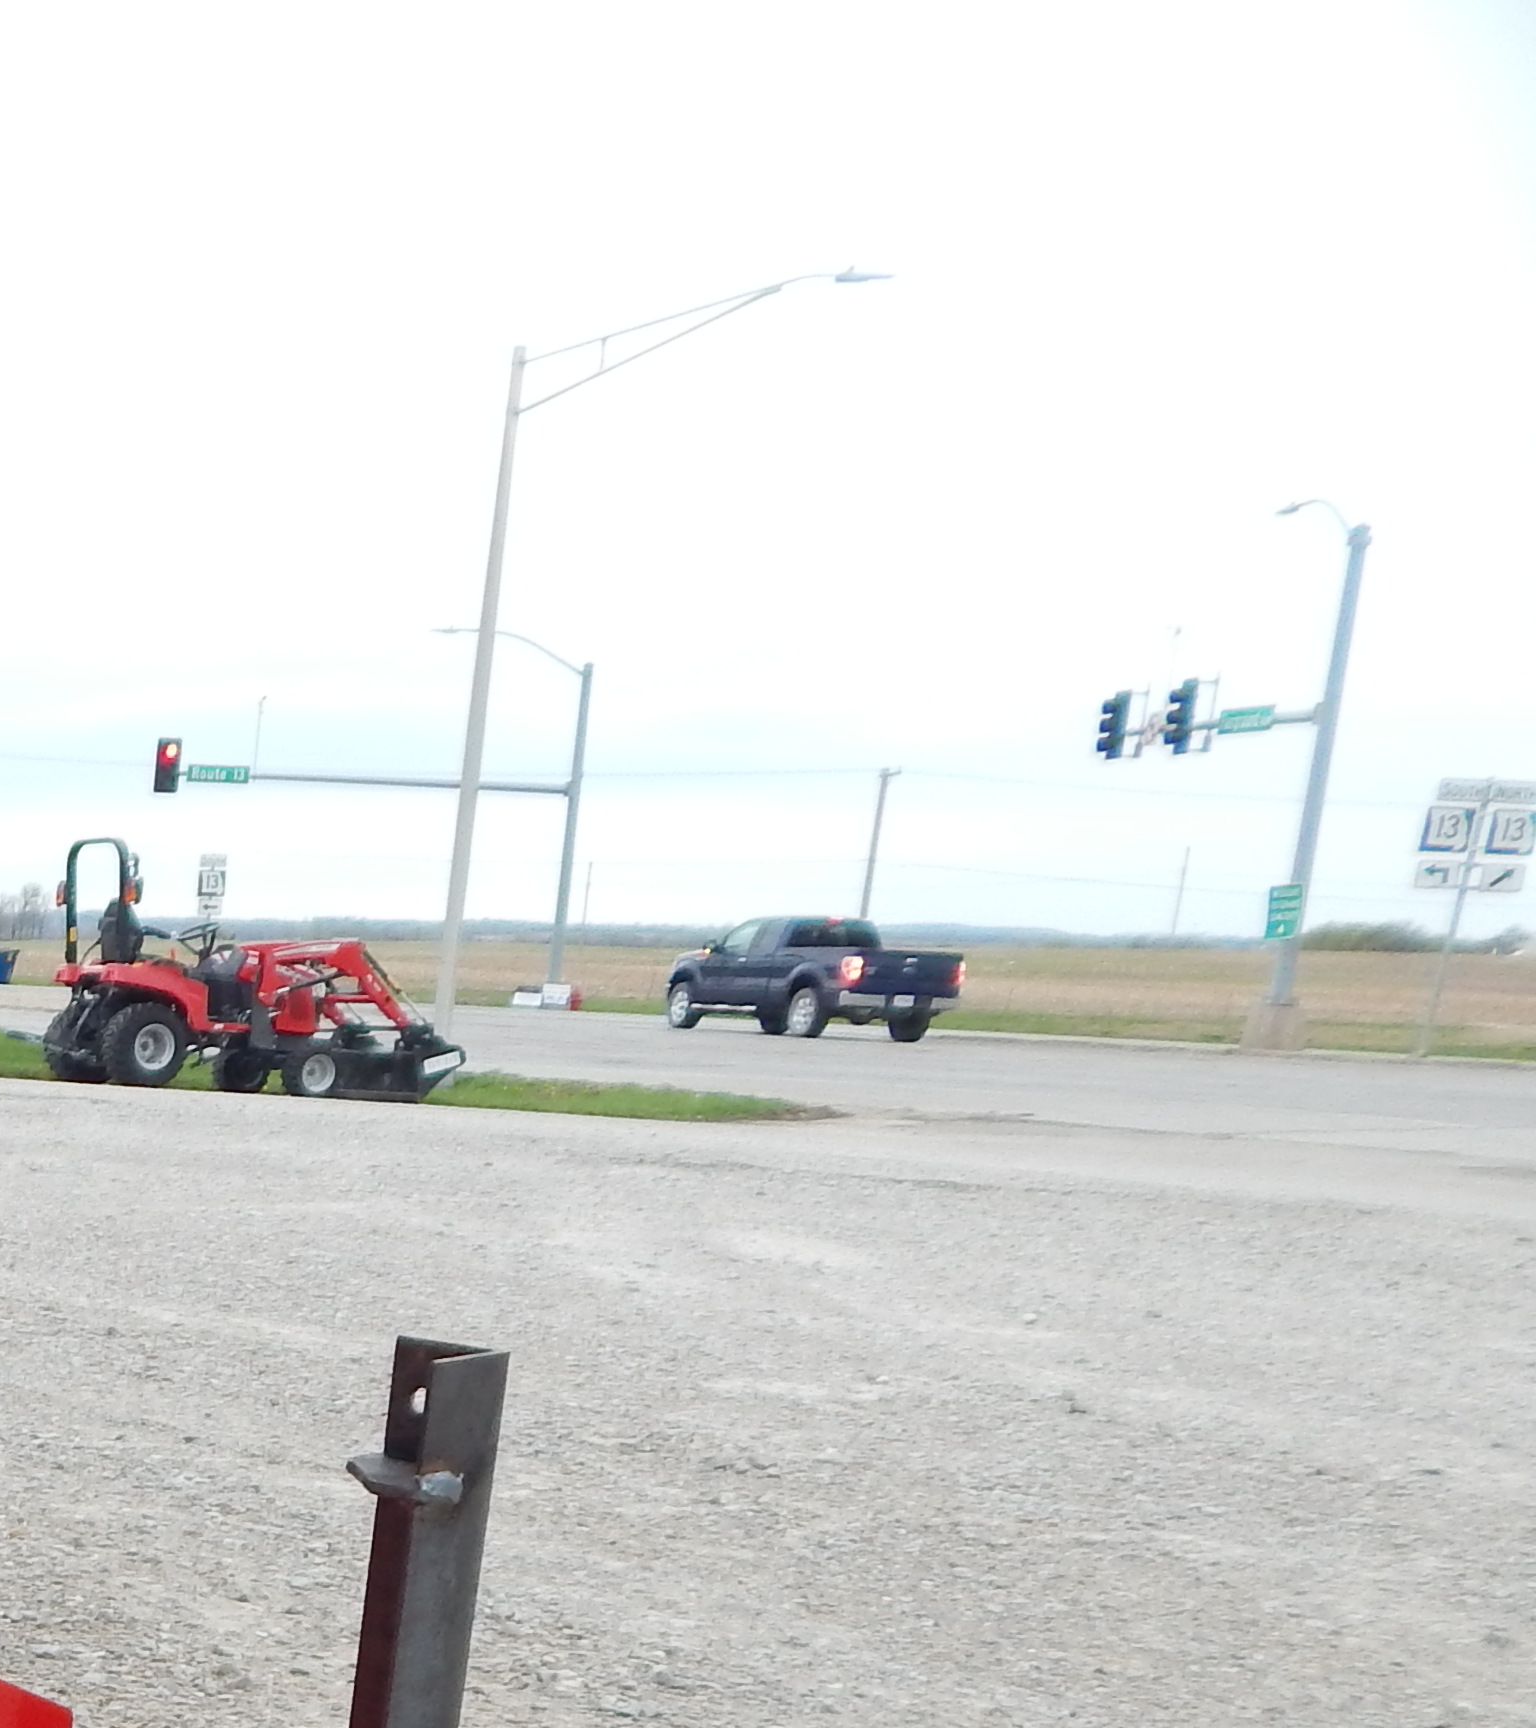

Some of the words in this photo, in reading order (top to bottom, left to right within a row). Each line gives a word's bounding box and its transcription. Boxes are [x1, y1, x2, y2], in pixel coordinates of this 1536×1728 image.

[191, 766, 227, 780] Route
[233, 768, 245, 781] 13
[1436, 814, 1460, 839] 13
[1501, 817, 1528, 842] 13
[206, 874, 219, 889] 13
